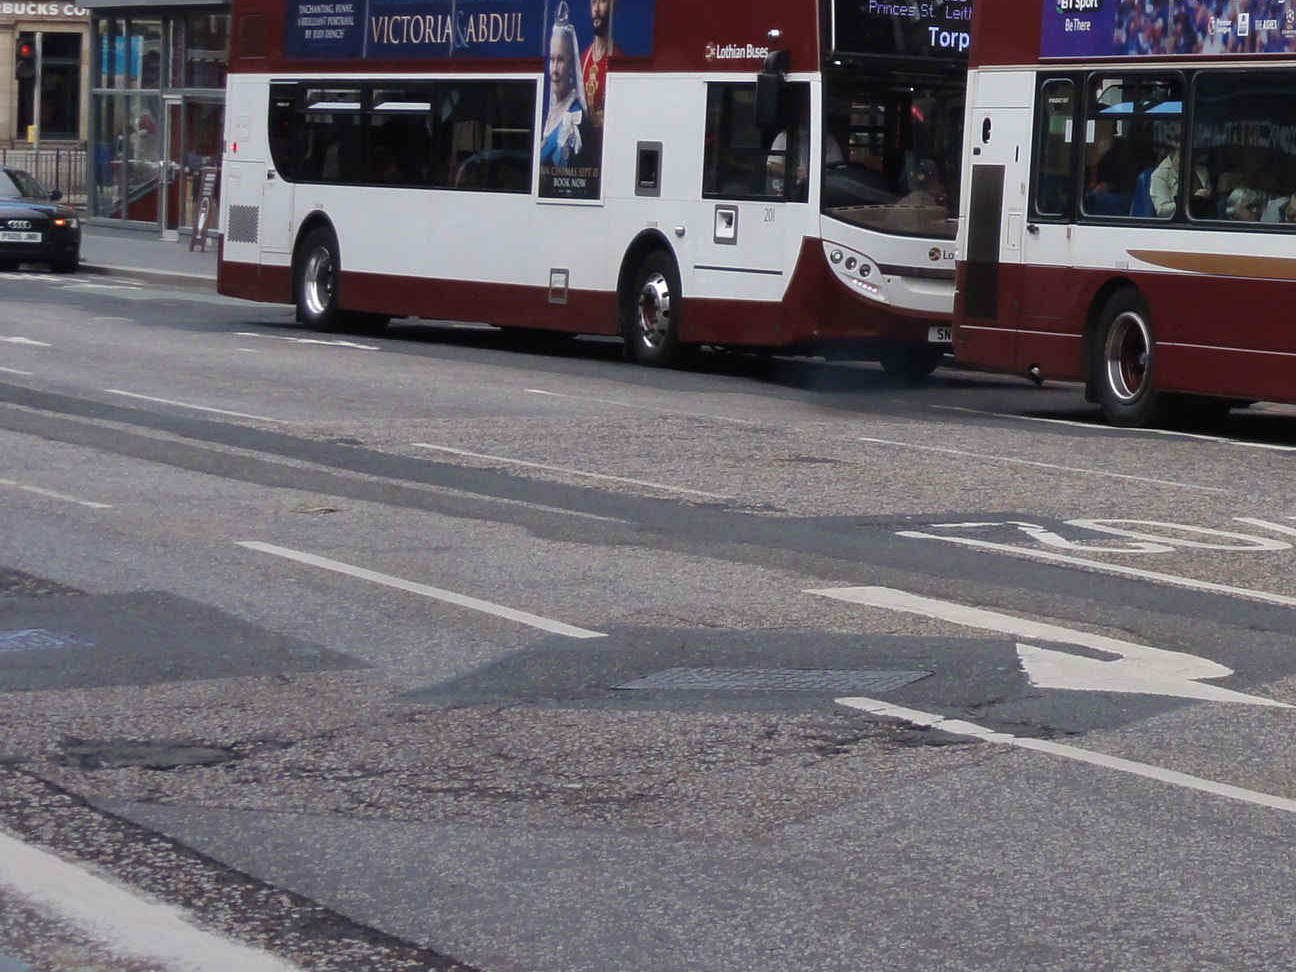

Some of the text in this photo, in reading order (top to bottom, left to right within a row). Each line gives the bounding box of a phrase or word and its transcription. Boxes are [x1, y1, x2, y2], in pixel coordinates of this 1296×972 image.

[0, 2, 59, 16] BUCKS
[868, 0, 917, 16] Princes
[371, 10, 525, 48] VICTORIA & ABDUL
[1064, 18, 1091, 32] Be There
[928, 26, 970, 52] Torp
[716, 43, 769, 59] Lothian Buses
[553, 177, 587, 188] BOOK NOW
[764, 207, 776, 223] 201
